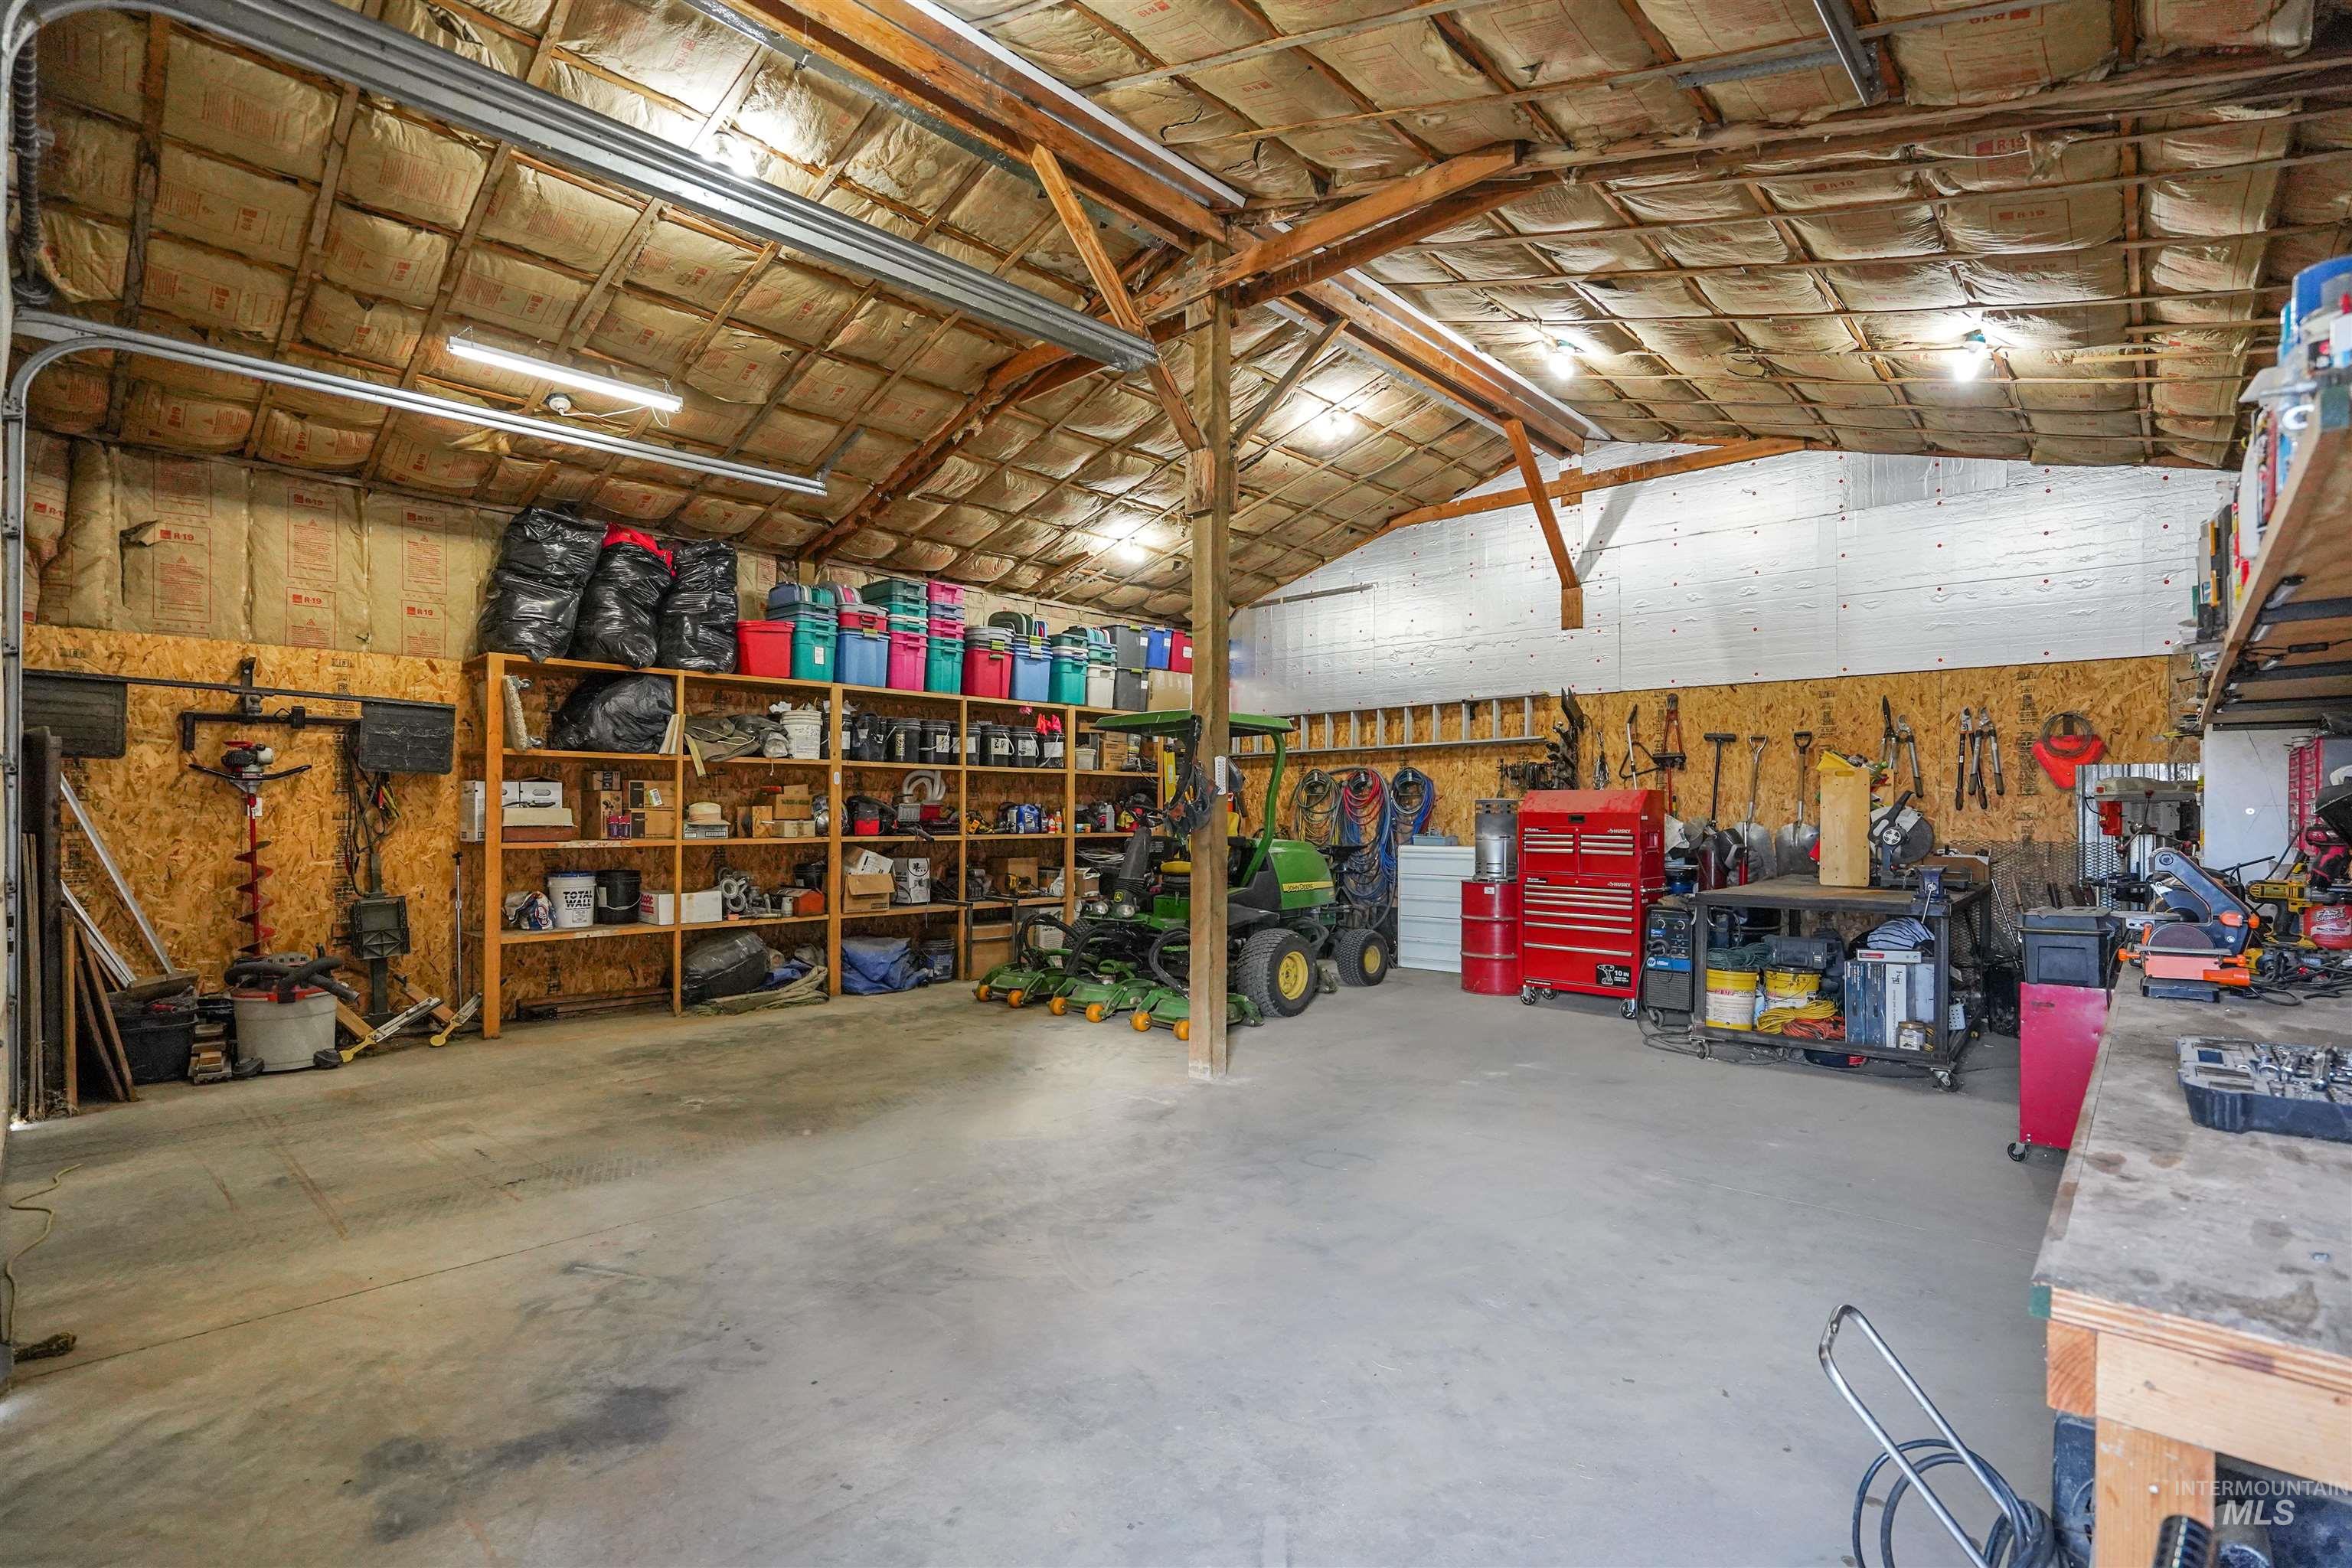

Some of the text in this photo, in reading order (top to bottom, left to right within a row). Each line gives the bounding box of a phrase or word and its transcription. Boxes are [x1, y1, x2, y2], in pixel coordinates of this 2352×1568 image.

[305, 498, 324, 506] R-19
[174, 532, 194, 541] R-19
[304, 596, 322, 605] R-19
[416, 608, 434, 616] R-19
[564, 890, 593, 900] TOTAL
[565, 899, 591, 908] WALL
